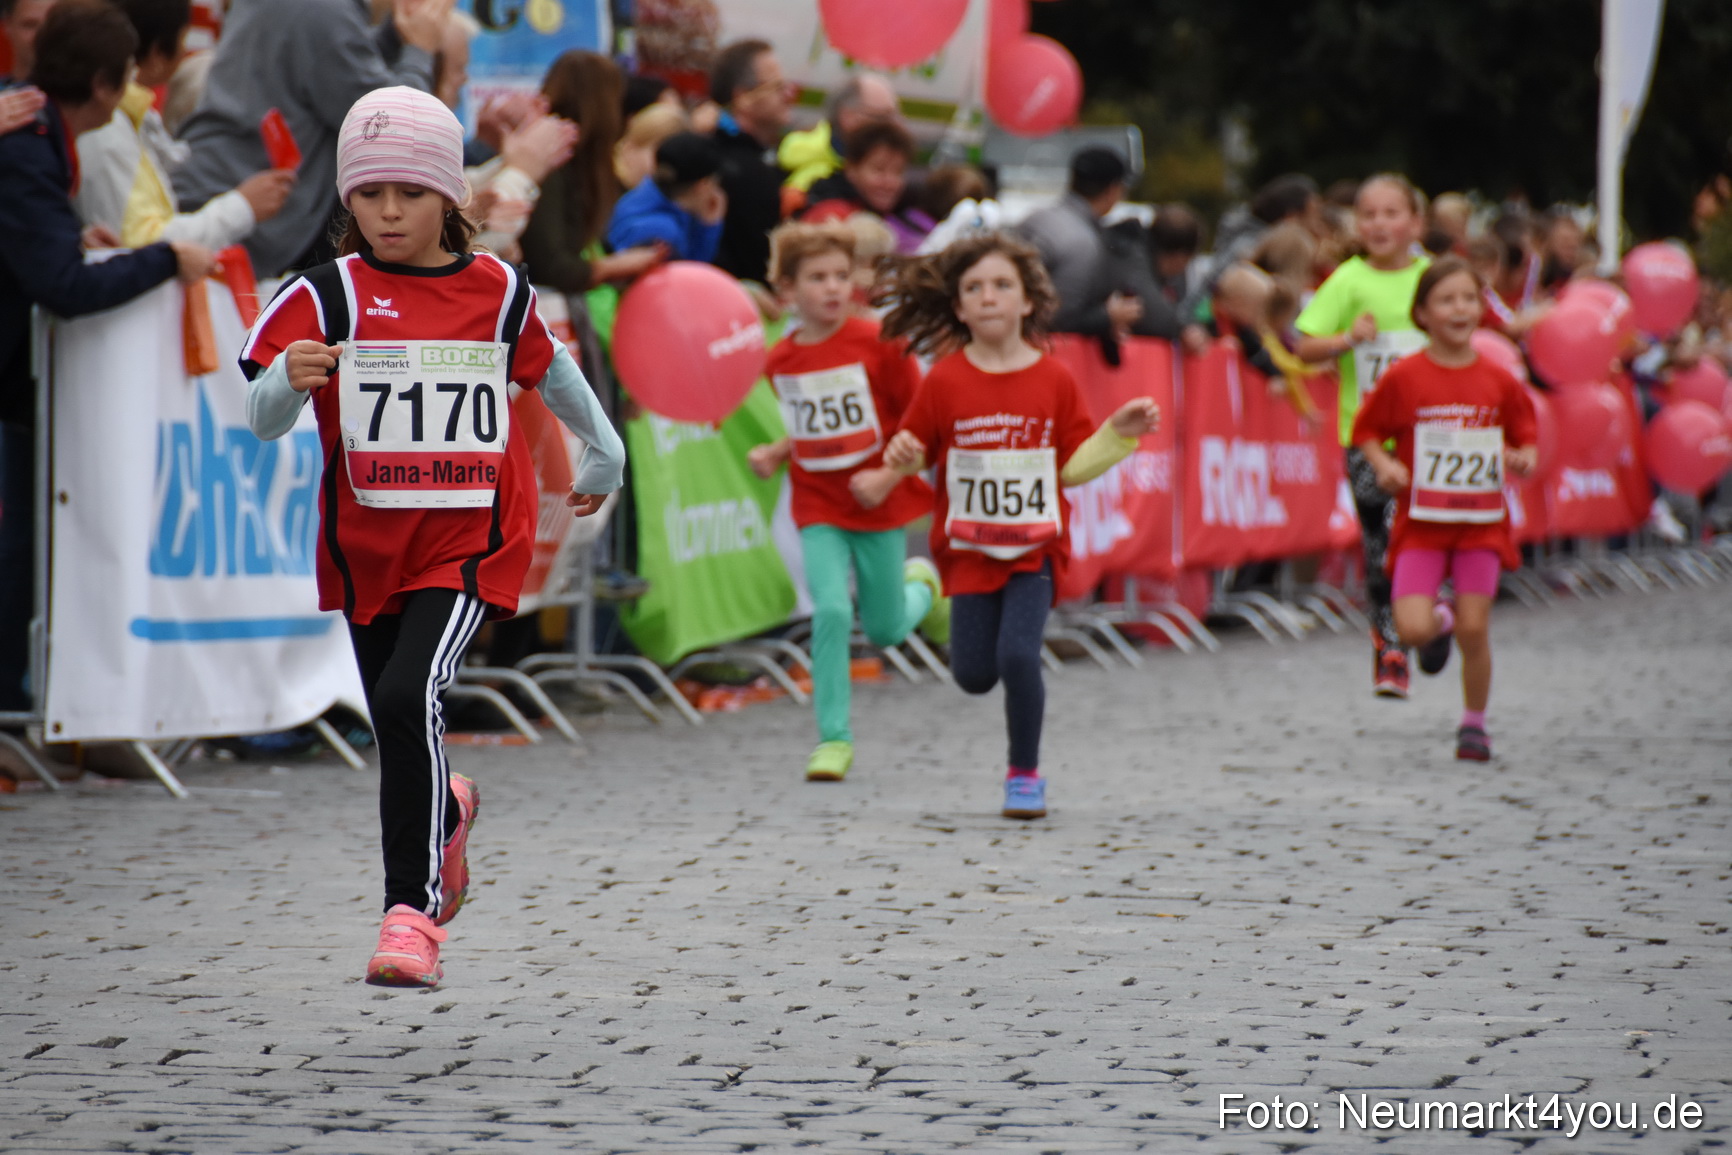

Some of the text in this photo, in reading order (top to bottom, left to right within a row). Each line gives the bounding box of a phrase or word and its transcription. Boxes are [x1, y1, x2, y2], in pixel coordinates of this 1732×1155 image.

[366, 307, 399, 318] erima
[354, 360, 410, 369] NeuerMarkt
[421, 346, 496, 367] BOCK
[420, 366, 448, 374] inspired
[448, 366, 457, 374] by
[474, 367, 495, 375] concepts
[359, 382, 498, 443] 7170
[787, 390, 864, 435] 7256
[348, 438, 356, 449] 3
[366, 460, 496, 484] Jana-Marie
[1425, 450, 1499, 486] 7224
[957, 477, 1046, 517] 7054
